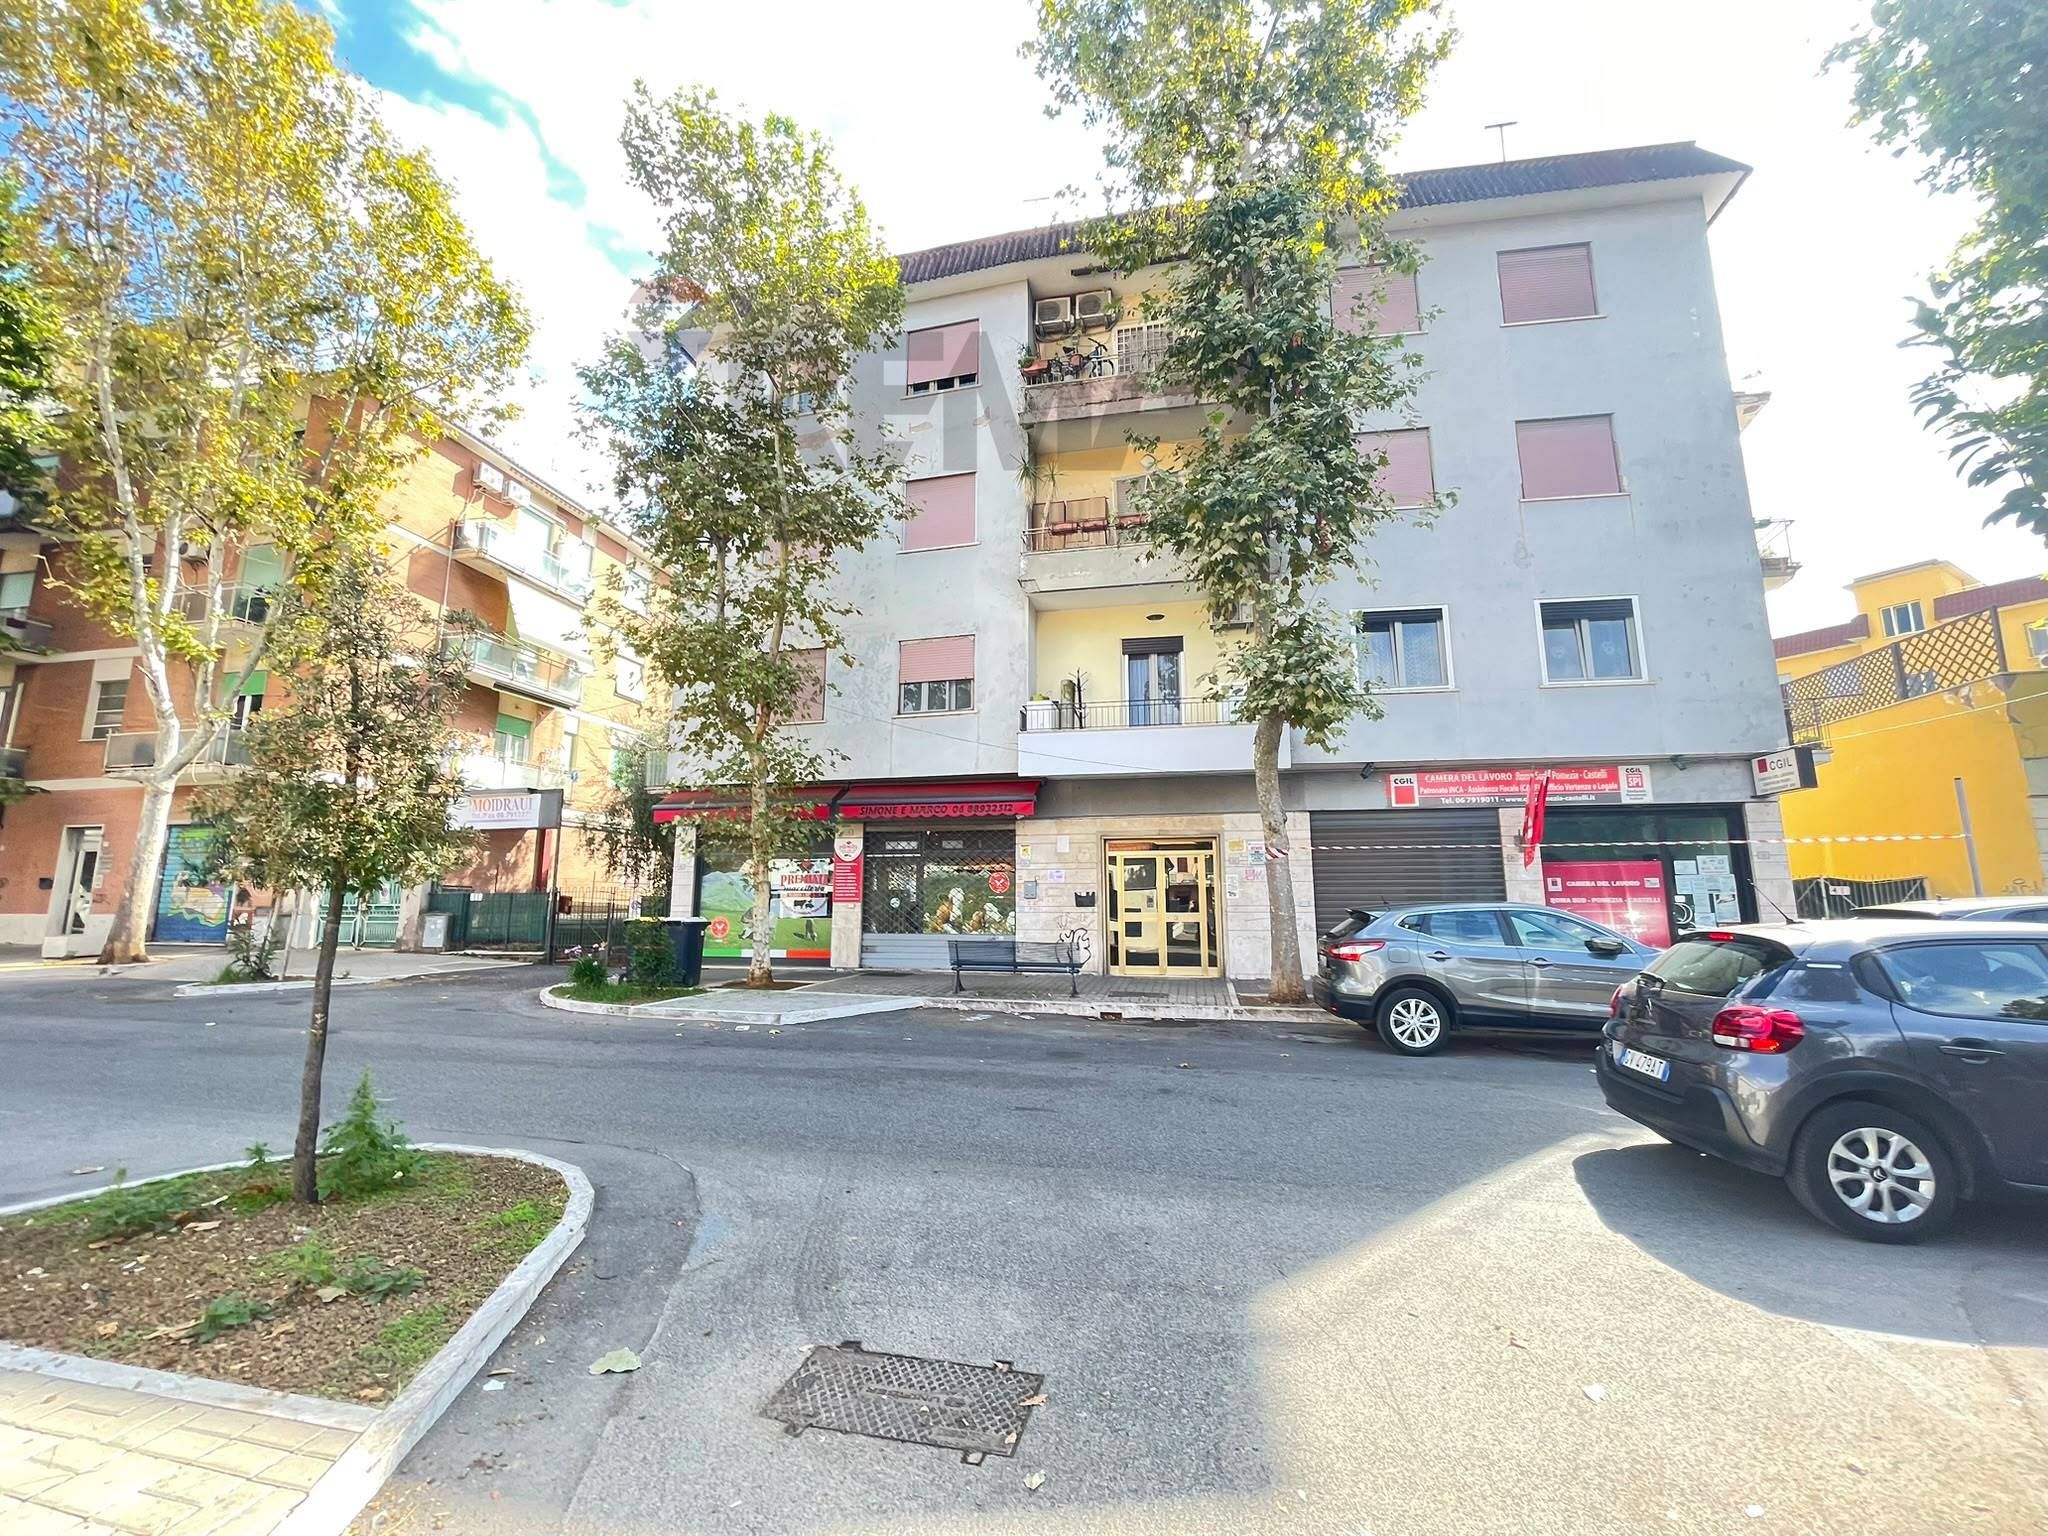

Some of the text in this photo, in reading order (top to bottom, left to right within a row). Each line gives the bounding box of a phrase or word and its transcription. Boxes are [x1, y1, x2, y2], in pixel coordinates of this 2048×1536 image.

[1769, 758, 1792, 770] CGIL
[1393, 777, 1414, 785] CGIL
[1424, 774, 1460, 783] CAMERA
[1461, 773, 1477, 783] DEL
[1479, 772, 1513, 782] LAVORO
[1627, 777, 1642, 787] SPI
[1420, 786, 1449, 795] Patronato
[1449, 785, 1464, 794] INCA
[1468, 785, 1499, 794] Assistenza
[1440, 797, 1454, 805] Tel.
[860, 805, 897, 816] SIMONE
[901, 805, 907, 815] E
[911, 805, 947, 815] MARCO
